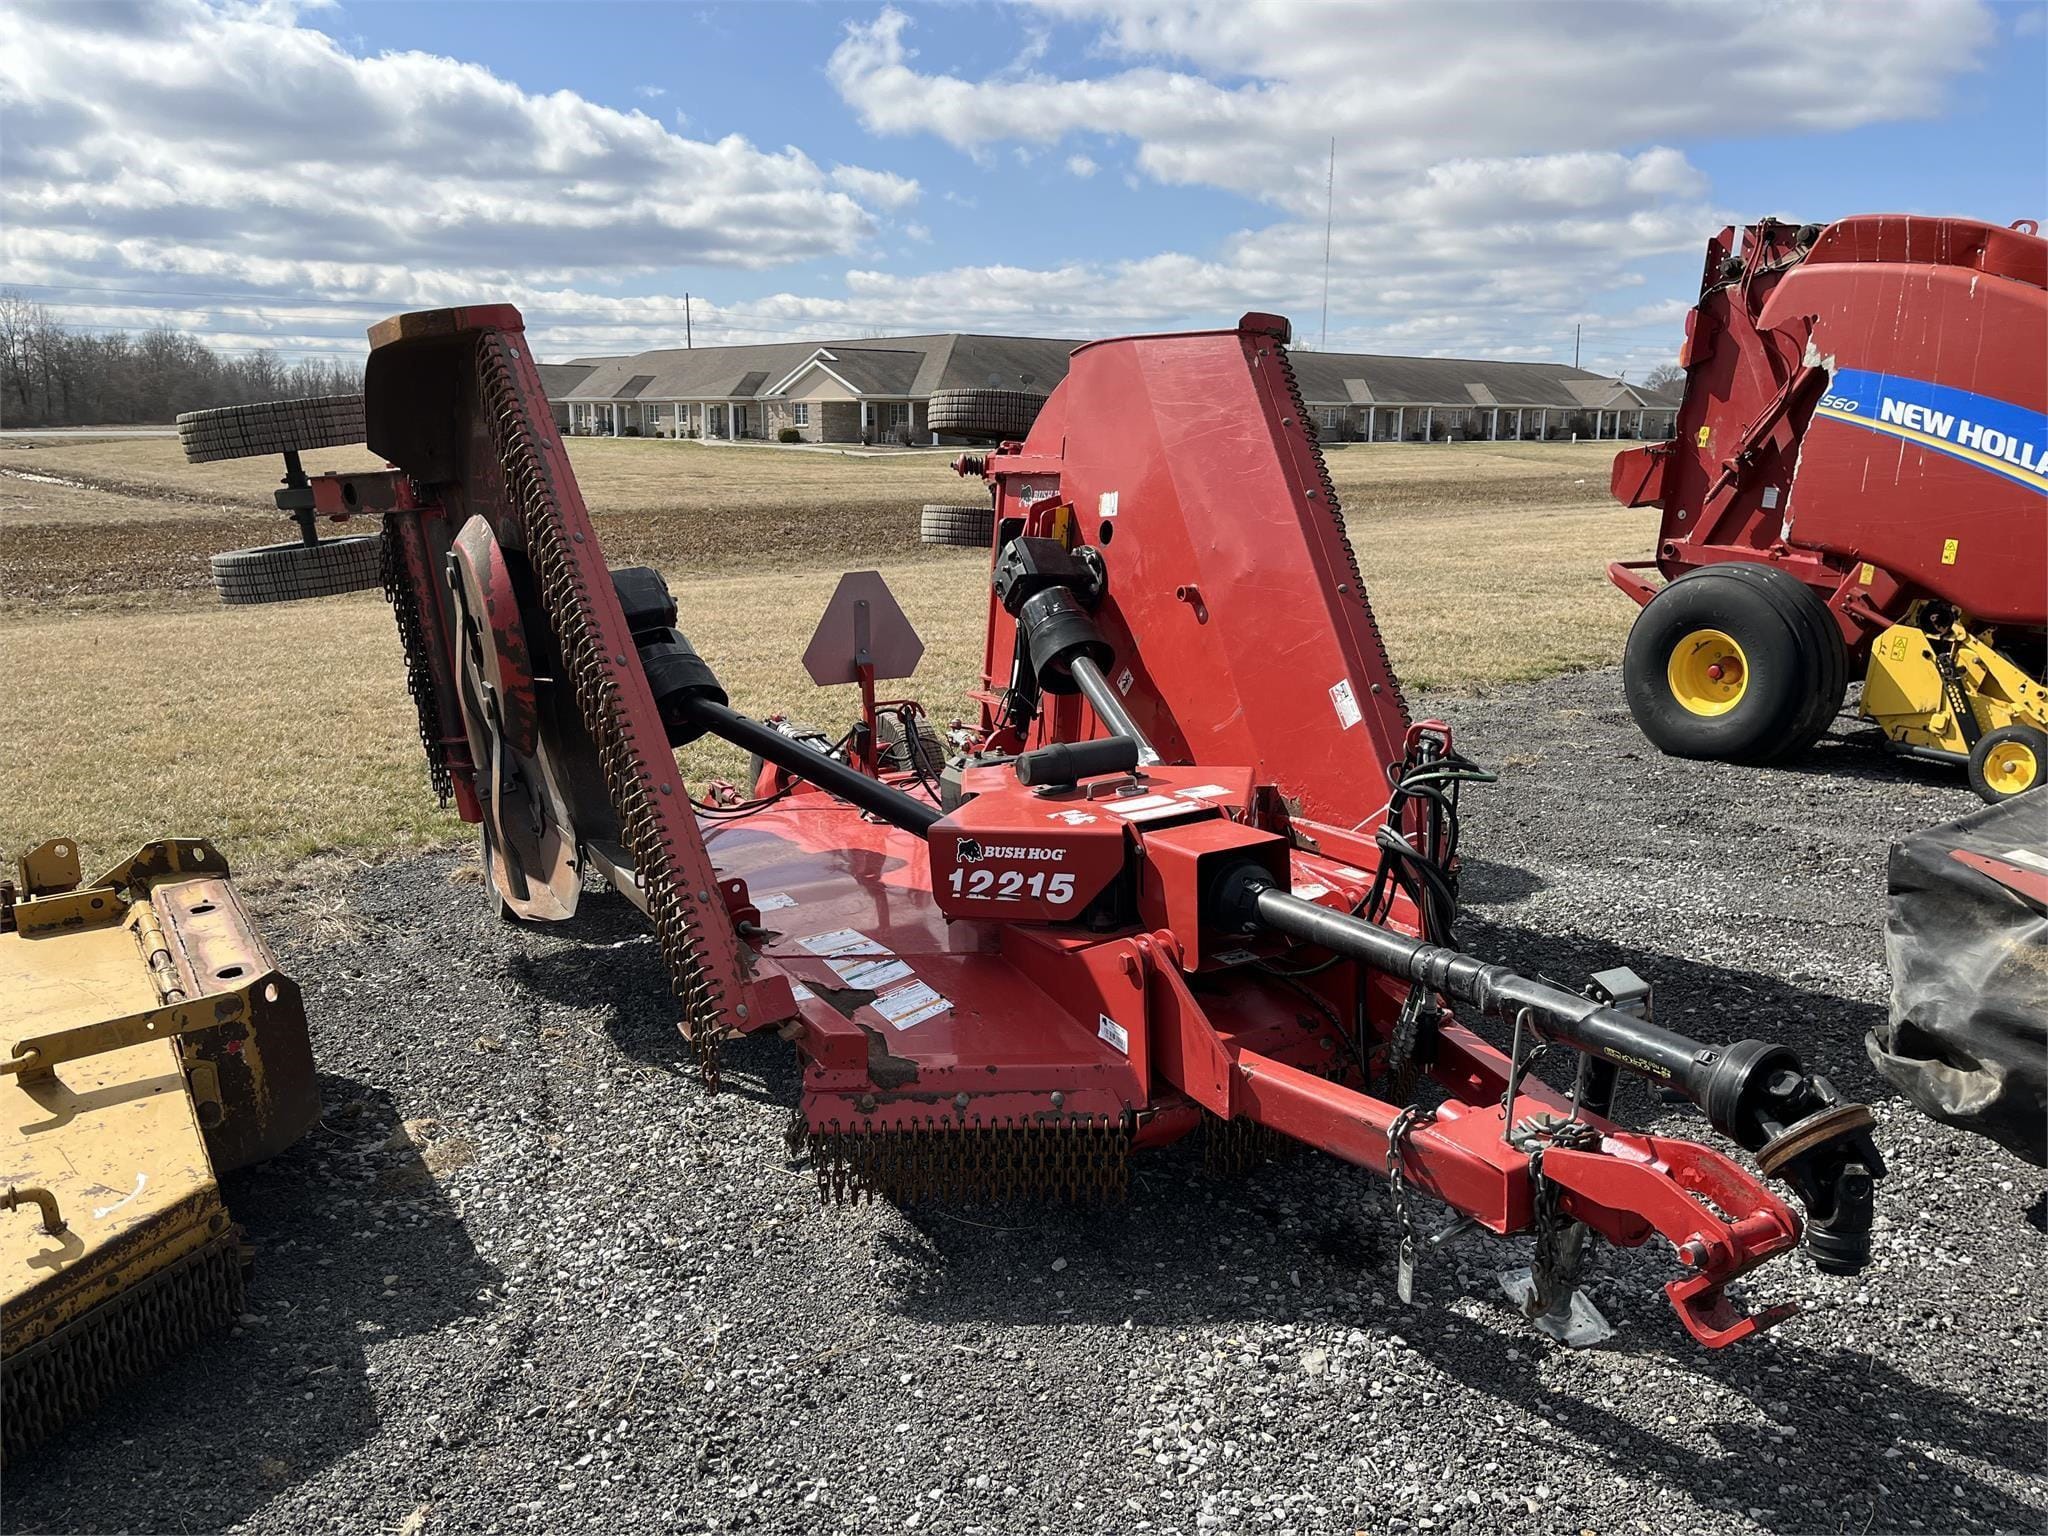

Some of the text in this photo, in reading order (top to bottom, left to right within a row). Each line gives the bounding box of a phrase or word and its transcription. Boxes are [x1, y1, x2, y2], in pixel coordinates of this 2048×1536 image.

[1820, 394, 1859, 412] 560
[1880, 397, 1956, 438] NEW
[984, 846, 1064, 860] BUSH HOG
[948, 868, 1076, 904] 12215
